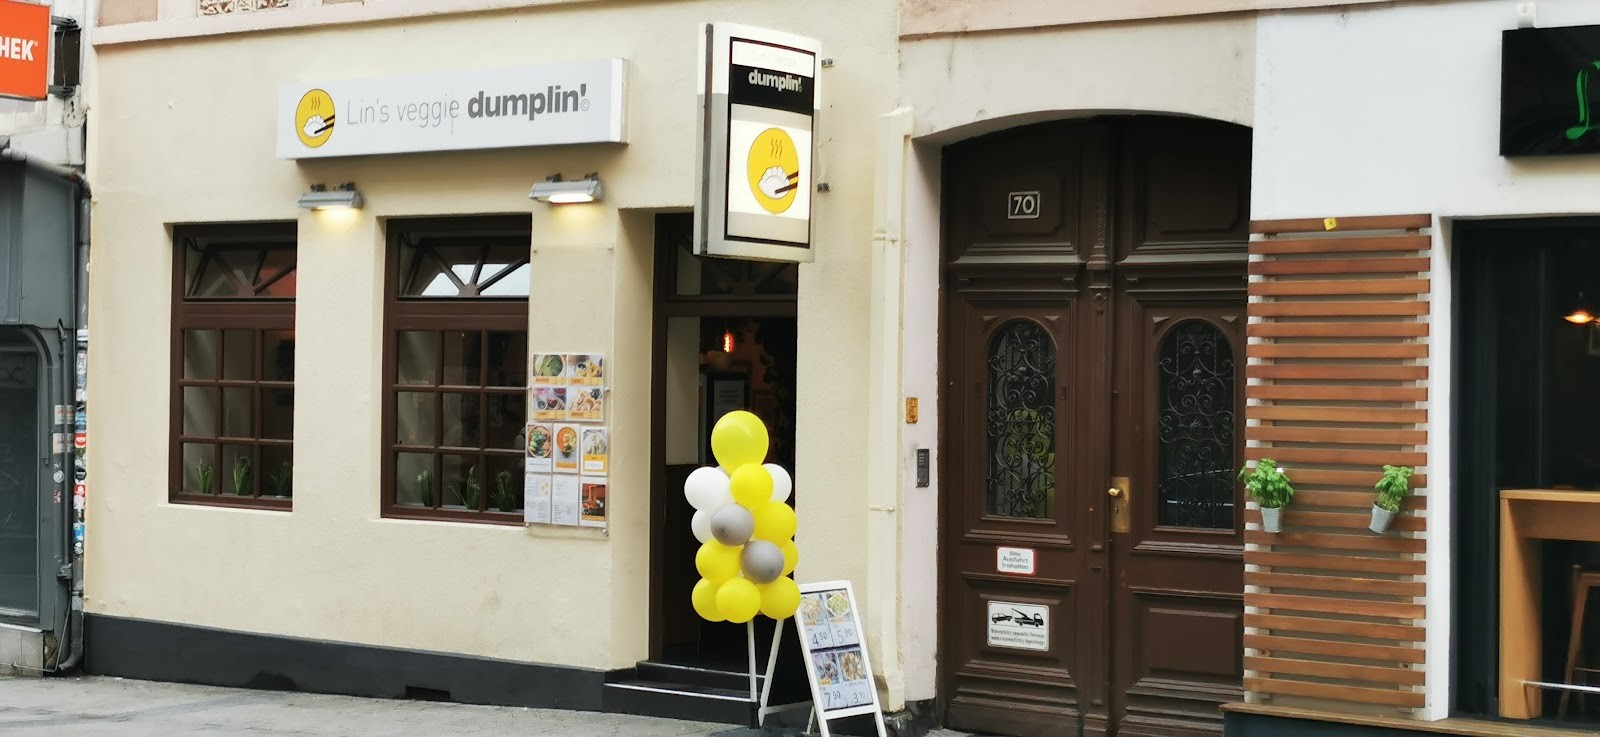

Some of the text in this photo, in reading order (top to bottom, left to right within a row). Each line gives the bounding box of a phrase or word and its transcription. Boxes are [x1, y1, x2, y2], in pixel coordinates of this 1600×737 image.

[748, 69, 802, 92] dumplin'
[346, 83, 587, 128] Lin's veggie dumplin'
[1013, 195, 1035, 214] 70
